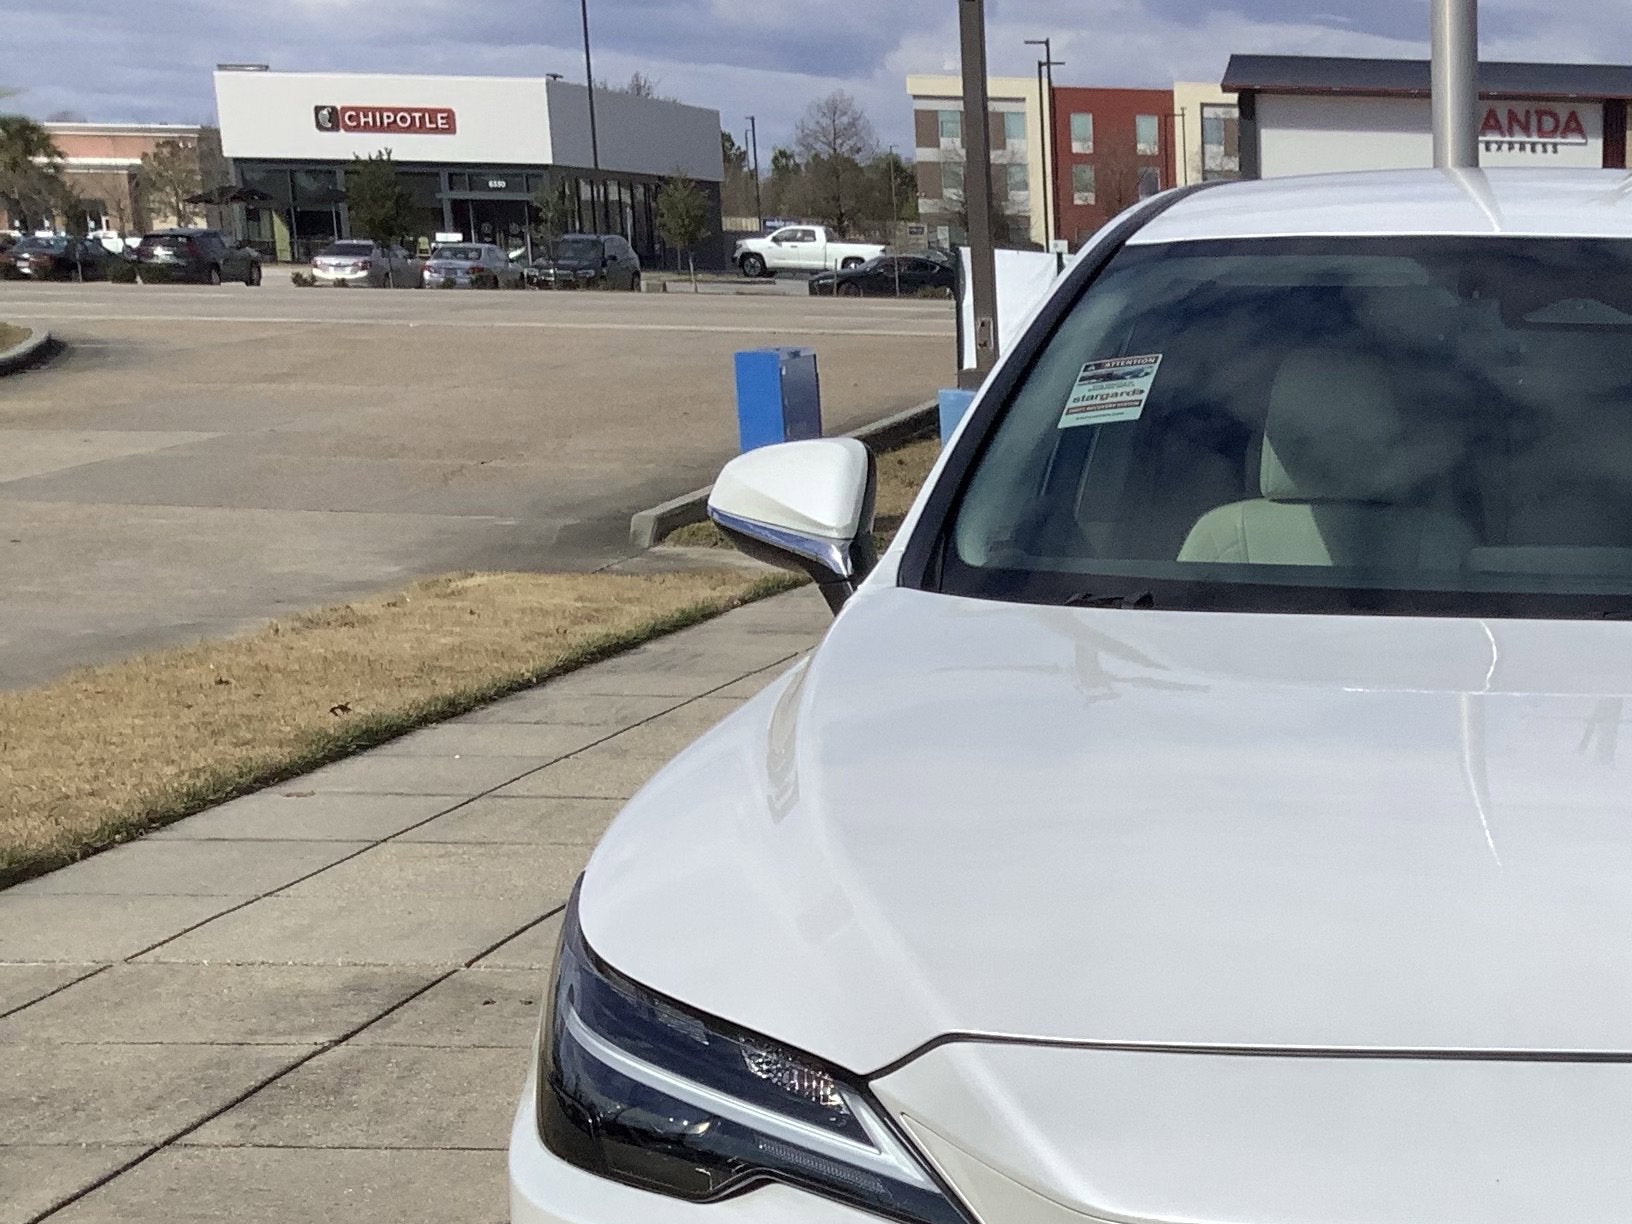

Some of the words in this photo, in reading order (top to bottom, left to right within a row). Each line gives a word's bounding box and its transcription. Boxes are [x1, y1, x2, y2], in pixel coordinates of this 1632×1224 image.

[344, 110, 450, 129] CHIPOTLE
[1480, 107, 1586, 138] ANDA
[1104, 357, 1156, 367] ATTENTION
